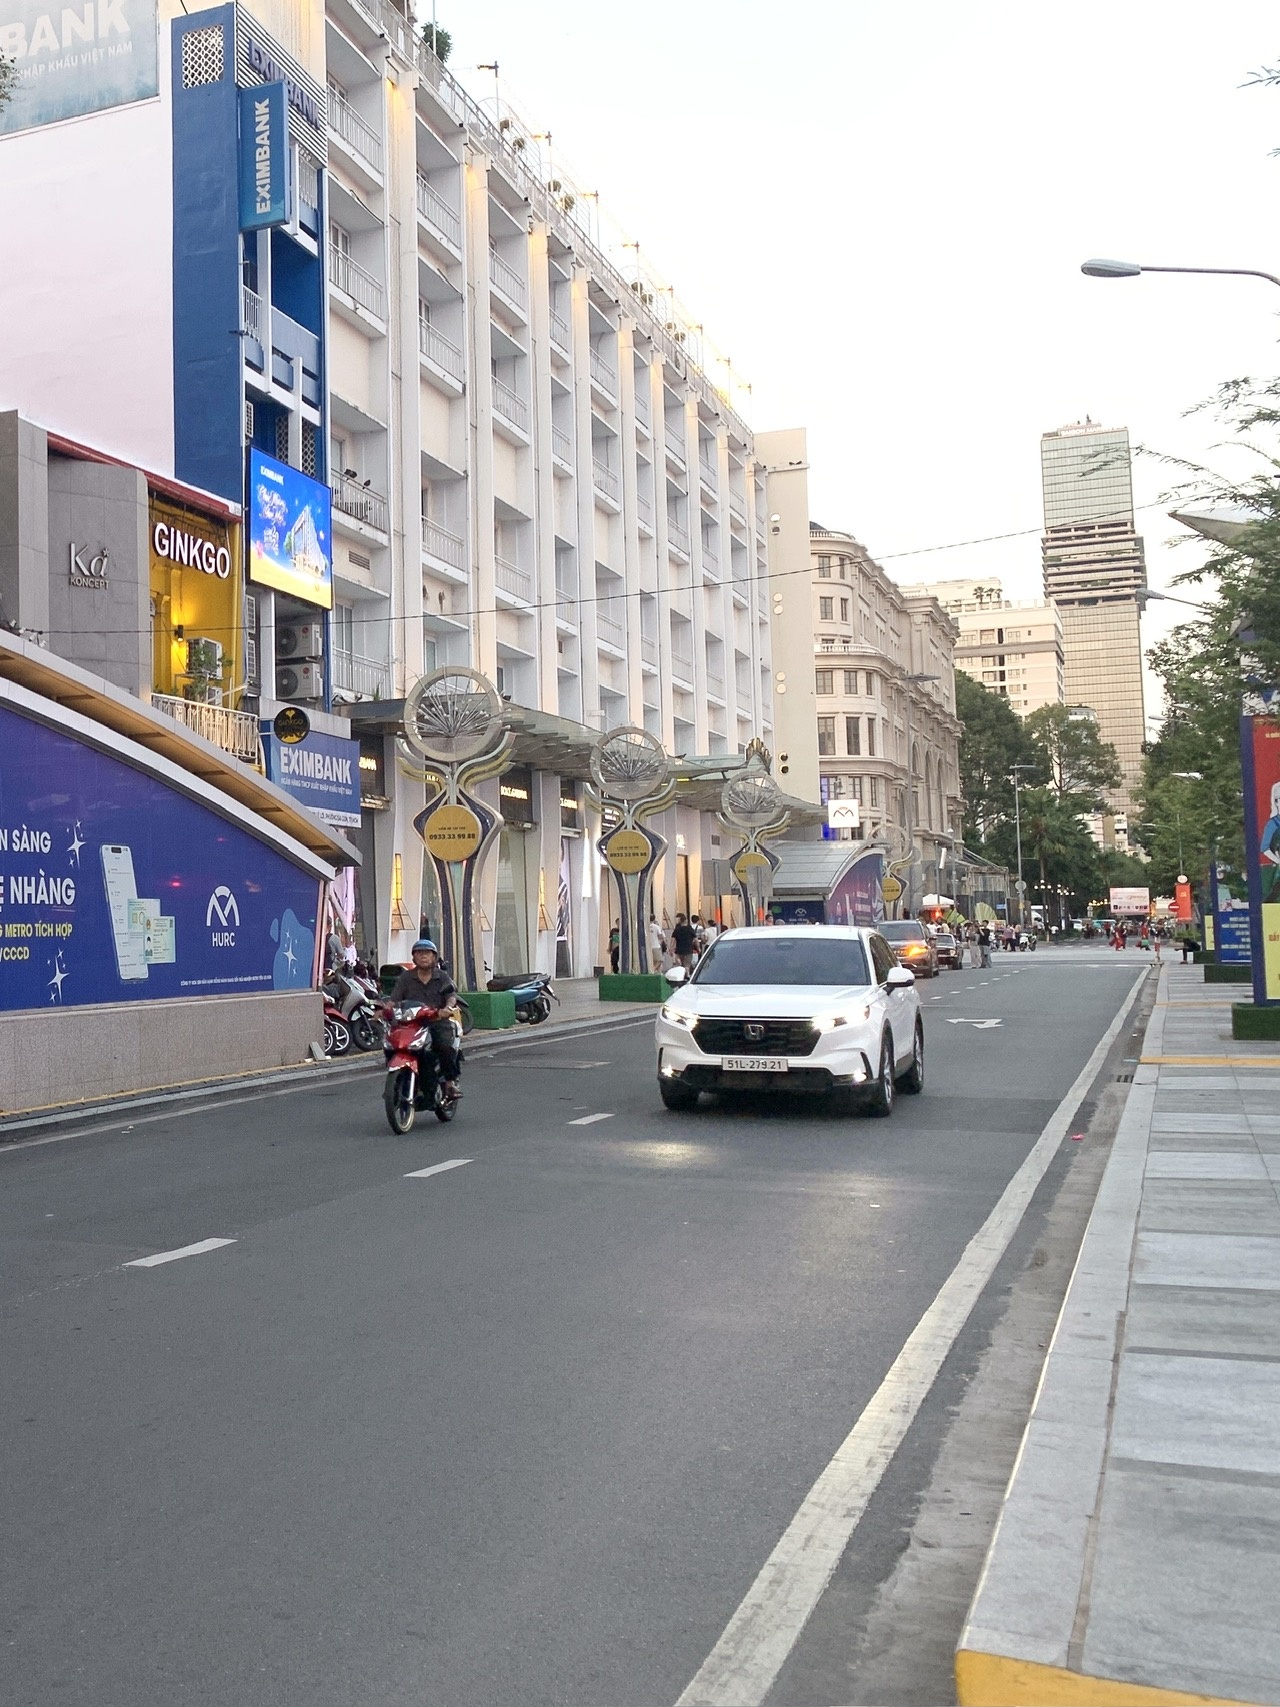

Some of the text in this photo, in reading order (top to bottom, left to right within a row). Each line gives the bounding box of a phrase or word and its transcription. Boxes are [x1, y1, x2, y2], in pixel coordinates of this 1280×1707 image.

[108, 41, 133, 56] NAM
[254, 98, 270, 214] EXIMBANK
[154, 521, 231, 580] GINKGO
[69, 576, 109, 590] KONCEPT
[280, 746, 352, 785] EXIMBANK
[12, 824, 51, 853] SÀNG
[10, 869, 76, 906] NHÀNG
[5, 923, 33, 938] METRO
[35, 919, 53, 937] TÍCH
[55, 921, 73, 941] HỢP
[212, 932, 236, 947] HURC
